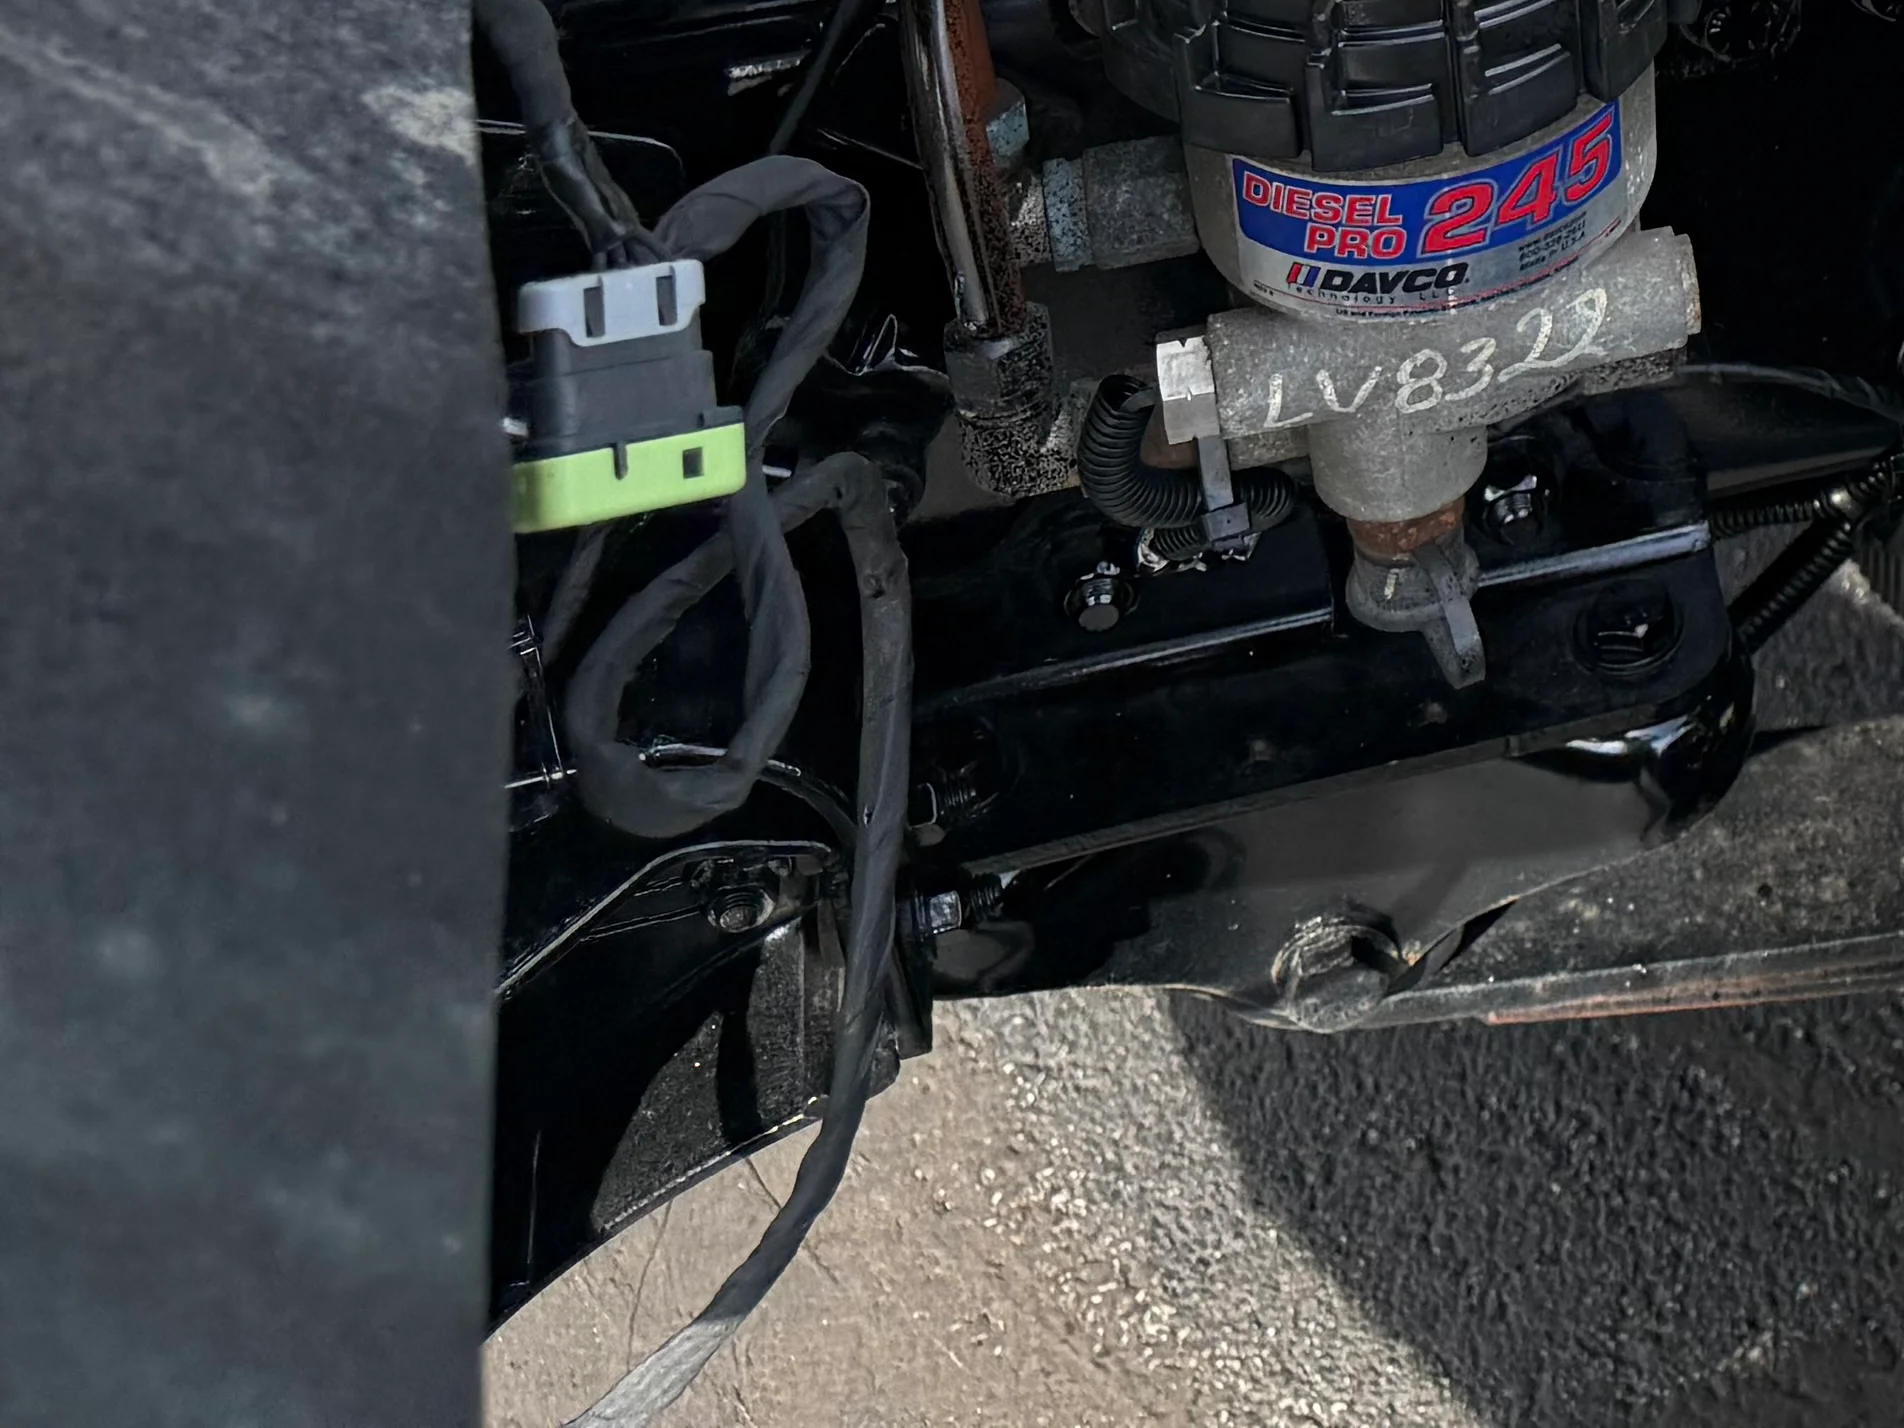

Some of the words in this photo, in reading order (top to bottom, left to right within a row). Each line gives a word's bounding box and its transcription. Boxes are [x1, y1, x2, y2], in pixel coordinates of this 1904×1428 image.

[1241, 169, 1404, 227] DIESEL
[1421, 110, 1614, 256] 245
[1303, 222, 1407, 261] PRO
